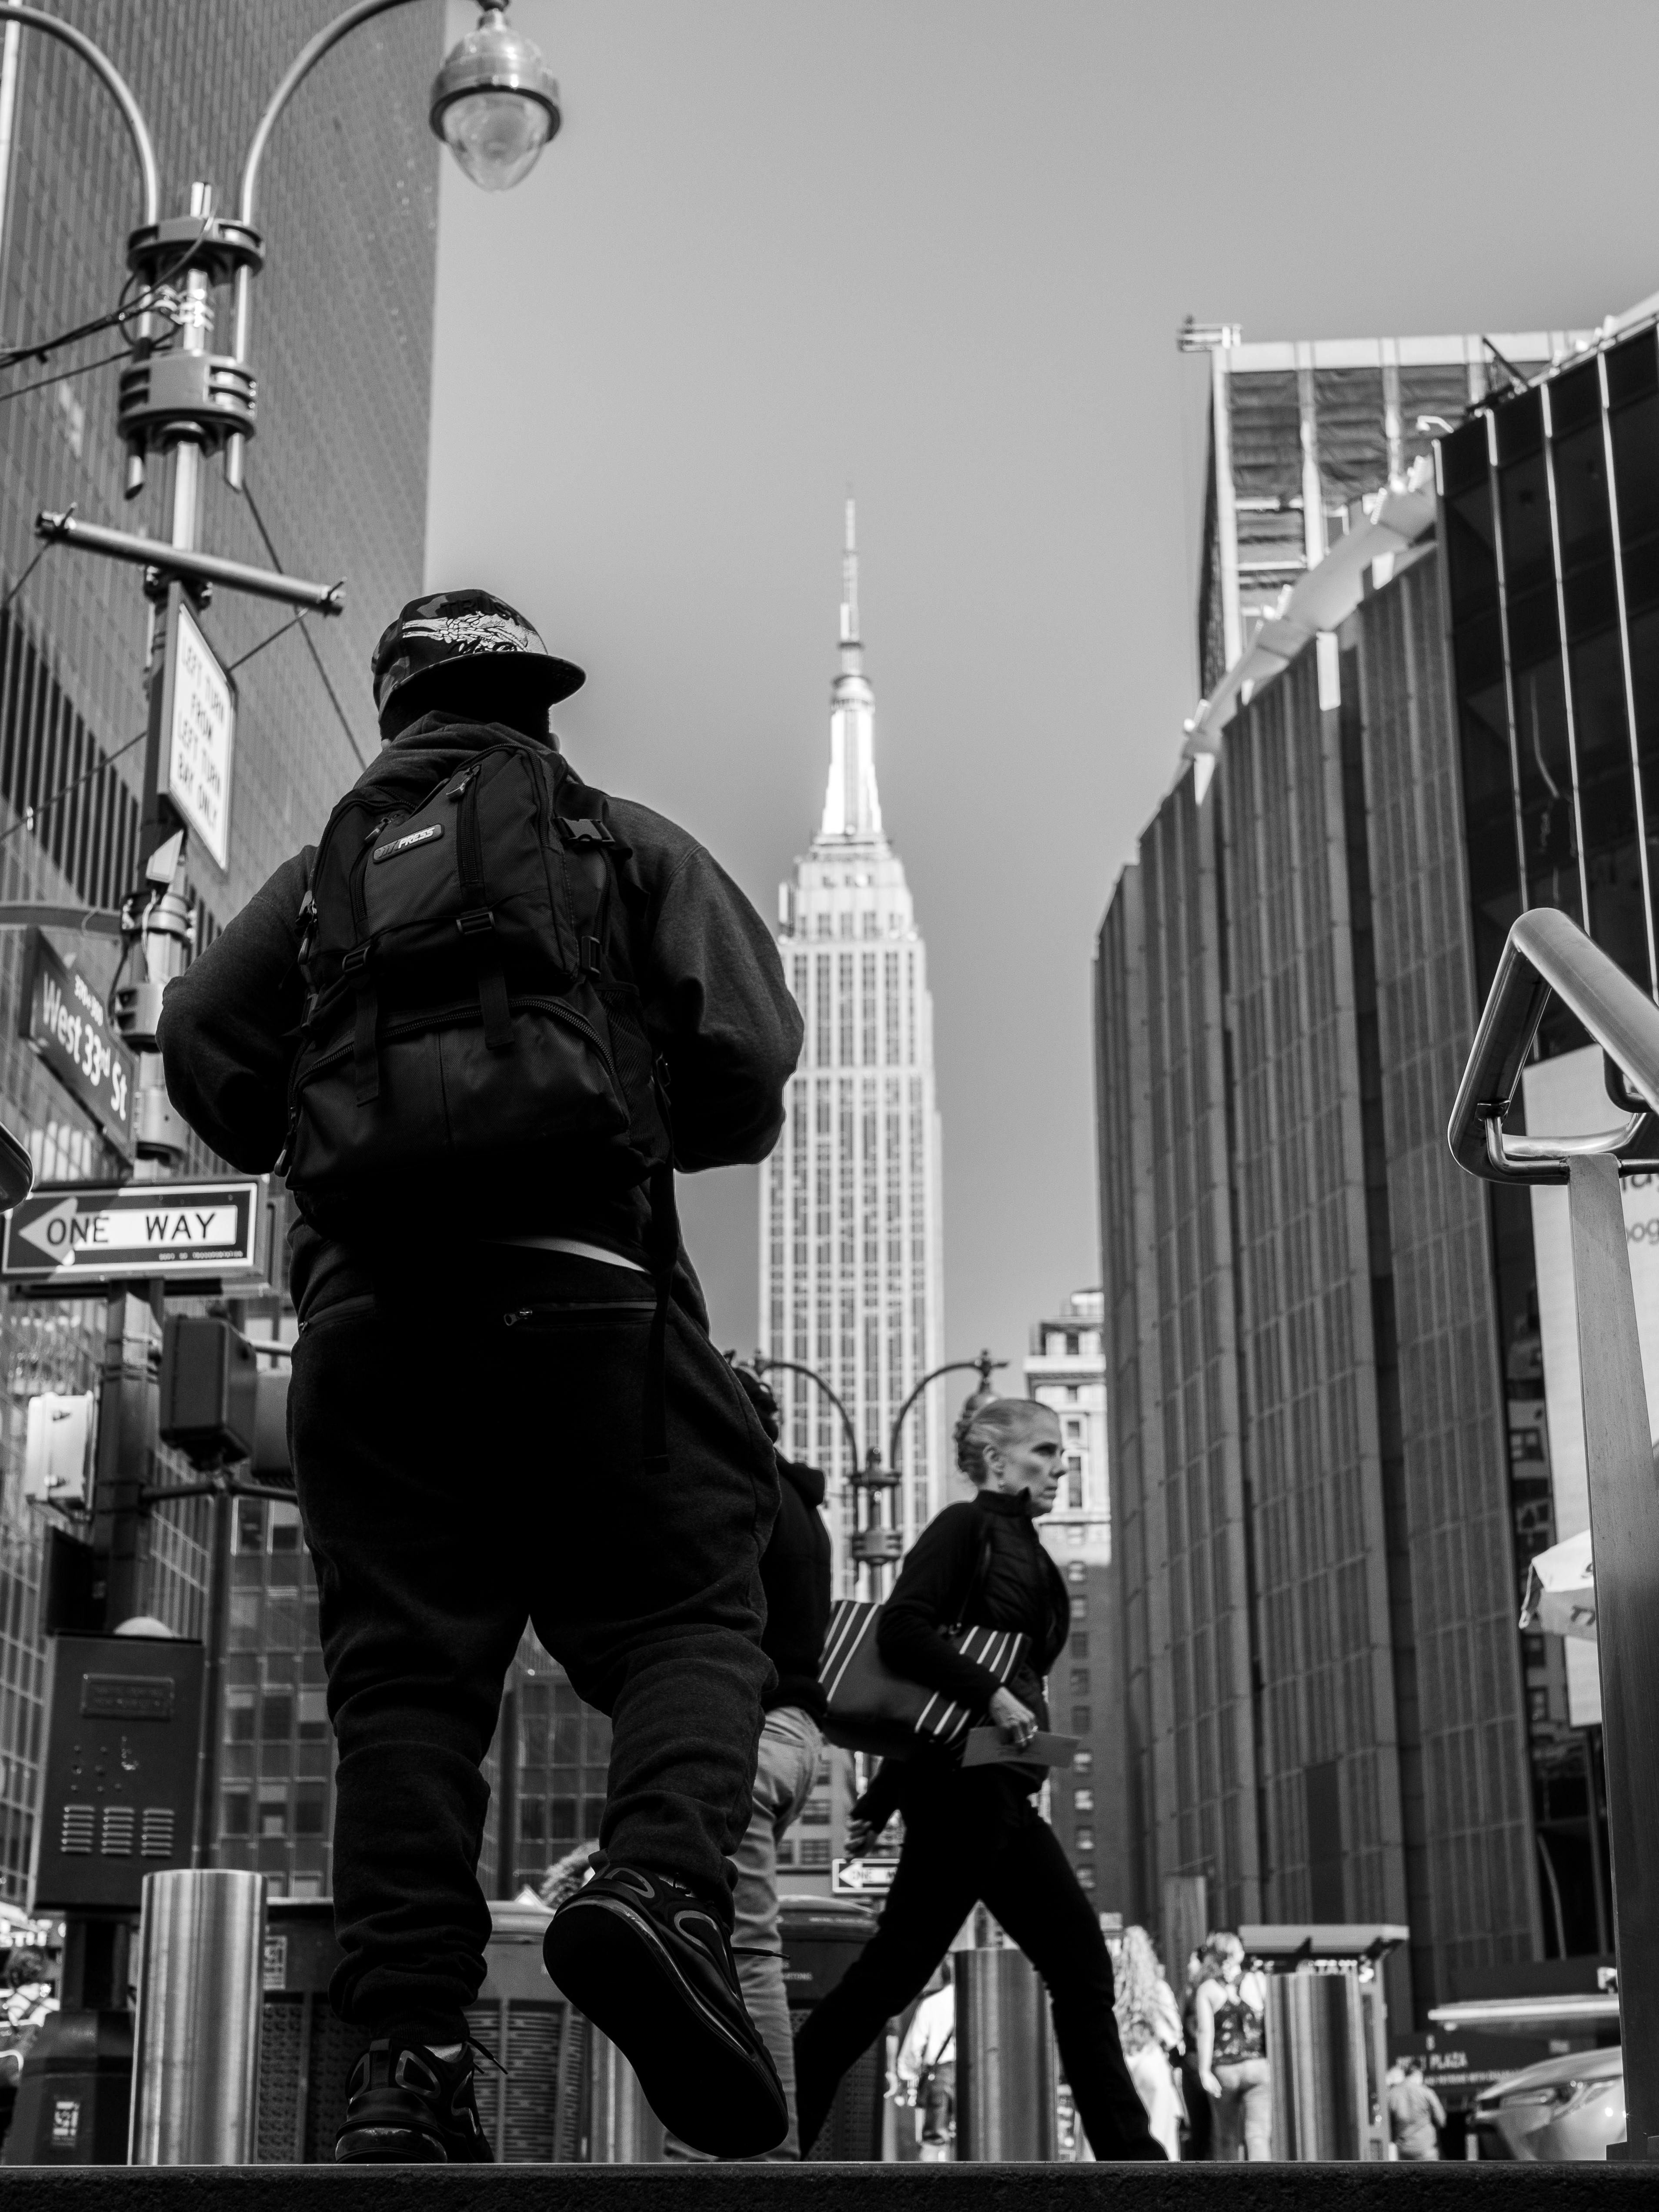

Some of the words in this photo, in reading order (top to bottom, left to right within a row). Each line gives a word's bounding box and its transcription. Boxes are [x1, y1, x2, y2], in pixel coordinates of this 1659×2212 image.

[181, 638, 203, 688] LEFT
[206, 677, 224, 727] TURN
[191, 692, 214, 744] FROM
[178, 712, 199, 763] LEFT
[201, 749, 220, 797] TURN
[197, 784, 218, 831] ONLY
[43, 971, 81, 1064] West
[82, 1024, 111, 1086] 33rd
[110, 1061, 127, 1121] St
[47, 1217, 110, 1245] ONE
[145, 1212, 216, 1241] WAY
[1429, 2051, 1469, 2071] PLAZA
